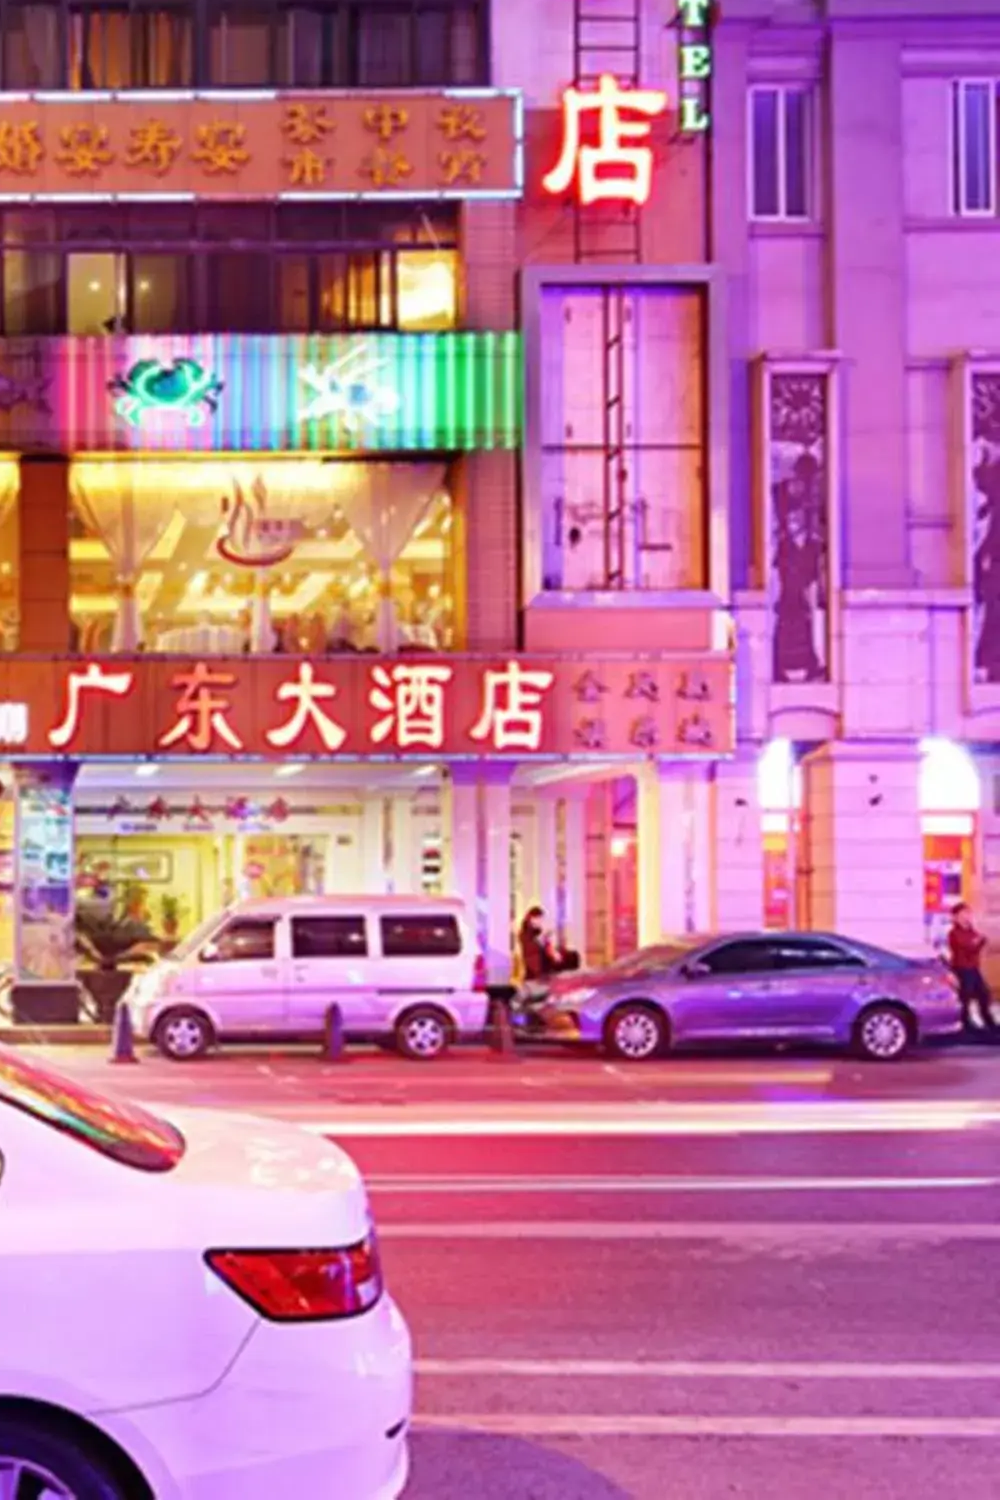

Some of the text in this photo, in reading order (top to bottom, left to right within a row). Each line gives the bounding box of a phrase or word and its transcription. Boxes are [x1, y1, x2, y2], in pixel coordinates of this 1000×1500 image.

[48, 660, 555, 750] 广东大酒店
